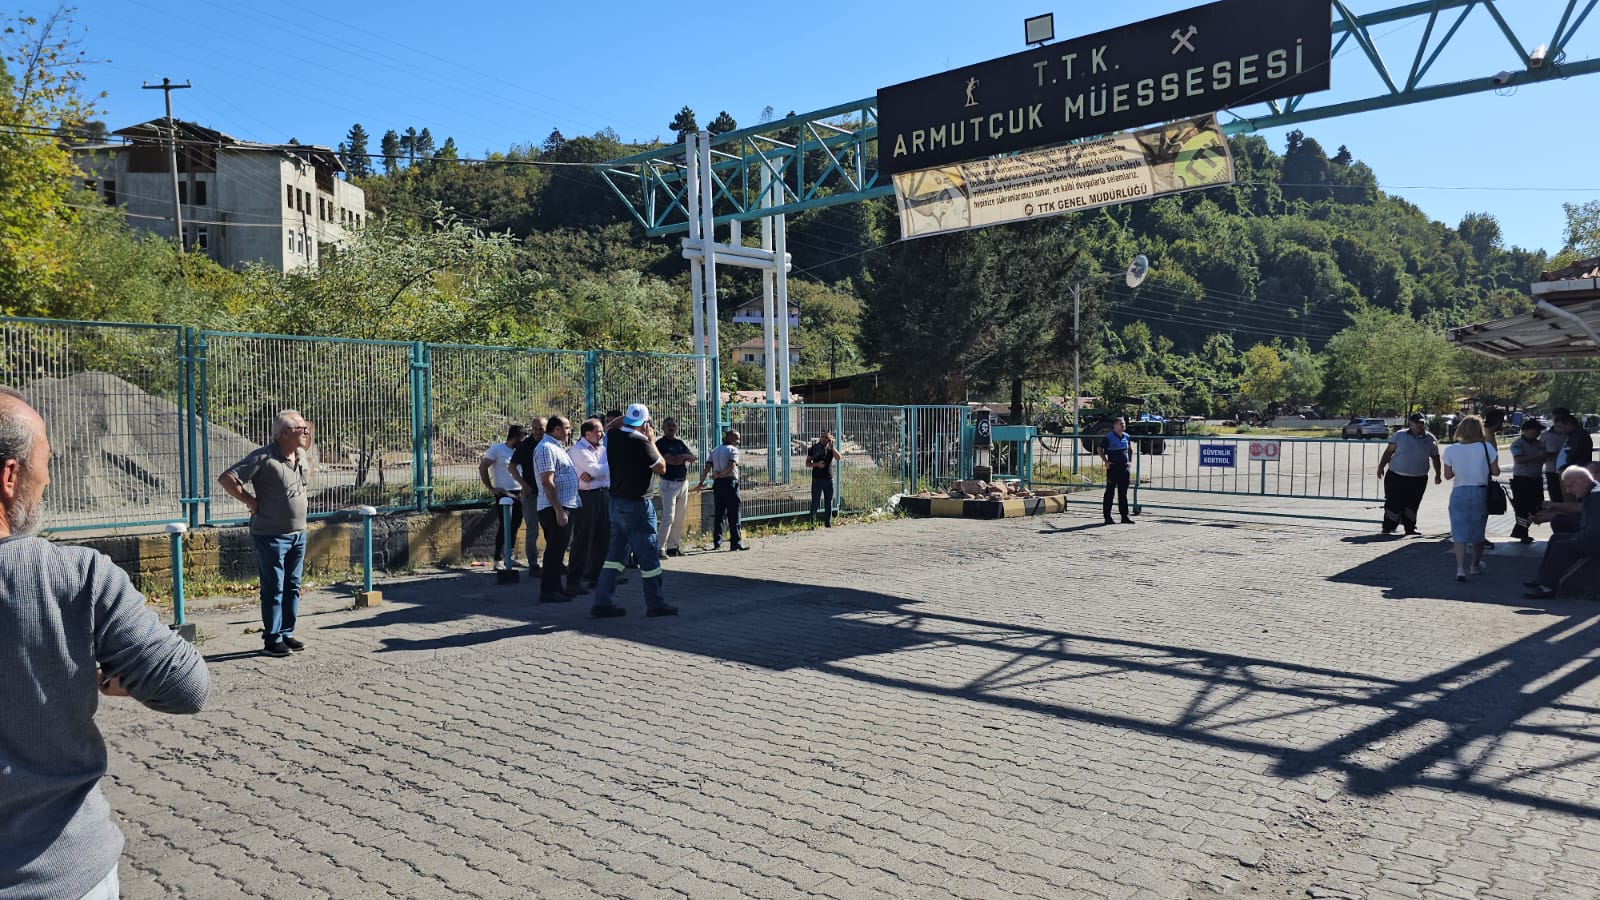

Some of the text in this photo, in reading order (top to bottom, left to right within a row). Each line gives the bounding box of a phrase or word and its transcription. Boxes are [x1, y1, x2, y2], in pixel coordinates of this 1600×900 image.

[1034, 45, 1120, 87] T.T.K.
[893, 38, 1303, 157] ARMUTÇUK MÜESSESESİ
[1038, 201, 1055, 212] TTK
[1058, 195, 1087, 209] GENEL
[1089, 184, 1147, 203] MÜDÜRLÜĞÜ
[1202, 448, 1231, 456] GÜVENLİK
